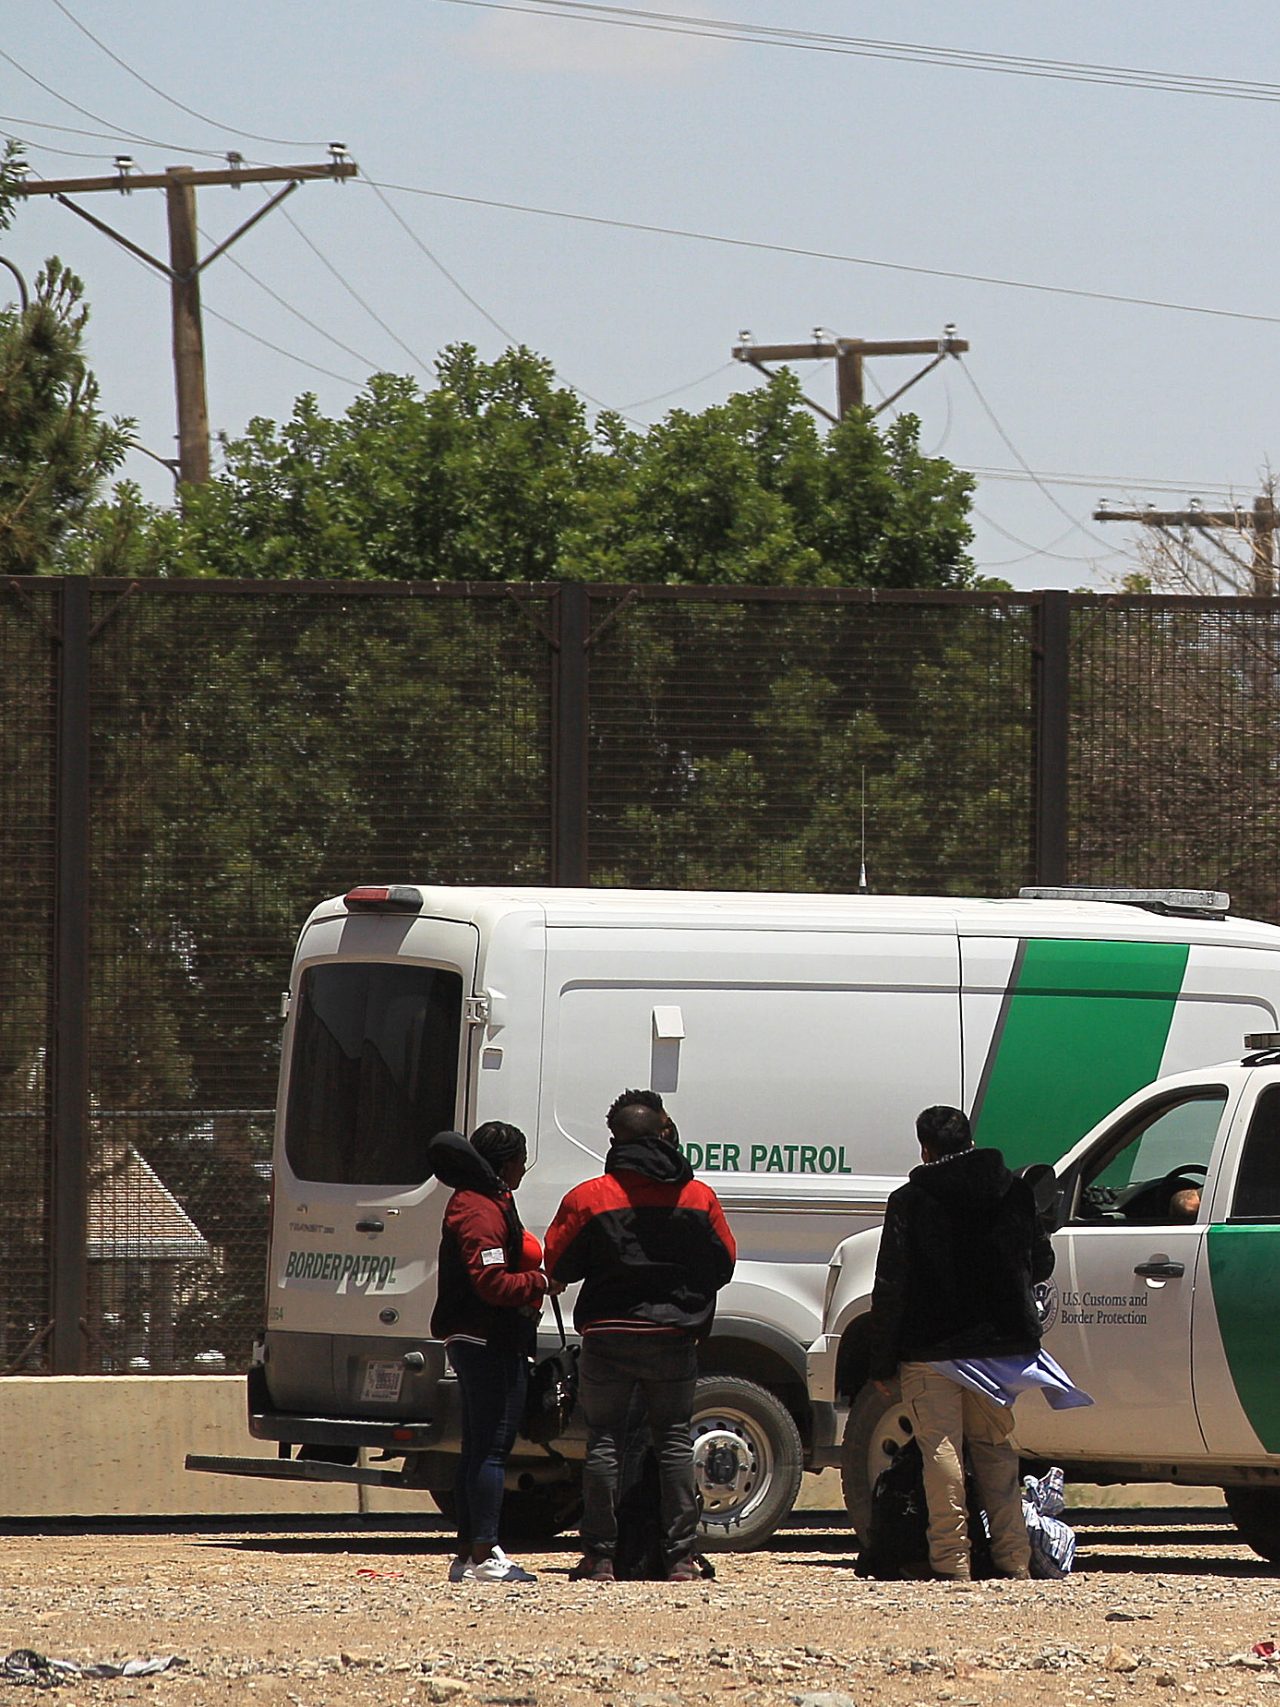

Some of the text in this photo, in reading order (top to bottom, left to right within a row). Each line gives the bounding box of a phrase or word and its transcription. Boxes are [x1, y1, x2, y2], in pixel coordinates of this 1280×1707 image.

[679, 1143, 852, 1173] DER PATROL
[285, 1251, 397, 1284] BORDER PATROL
[1062, 1292, 1148, 1307] U.S. Customs and
[1061, 1309, 1094, 1325] Border
[1097, 1309, 1148, 1325] Protection
